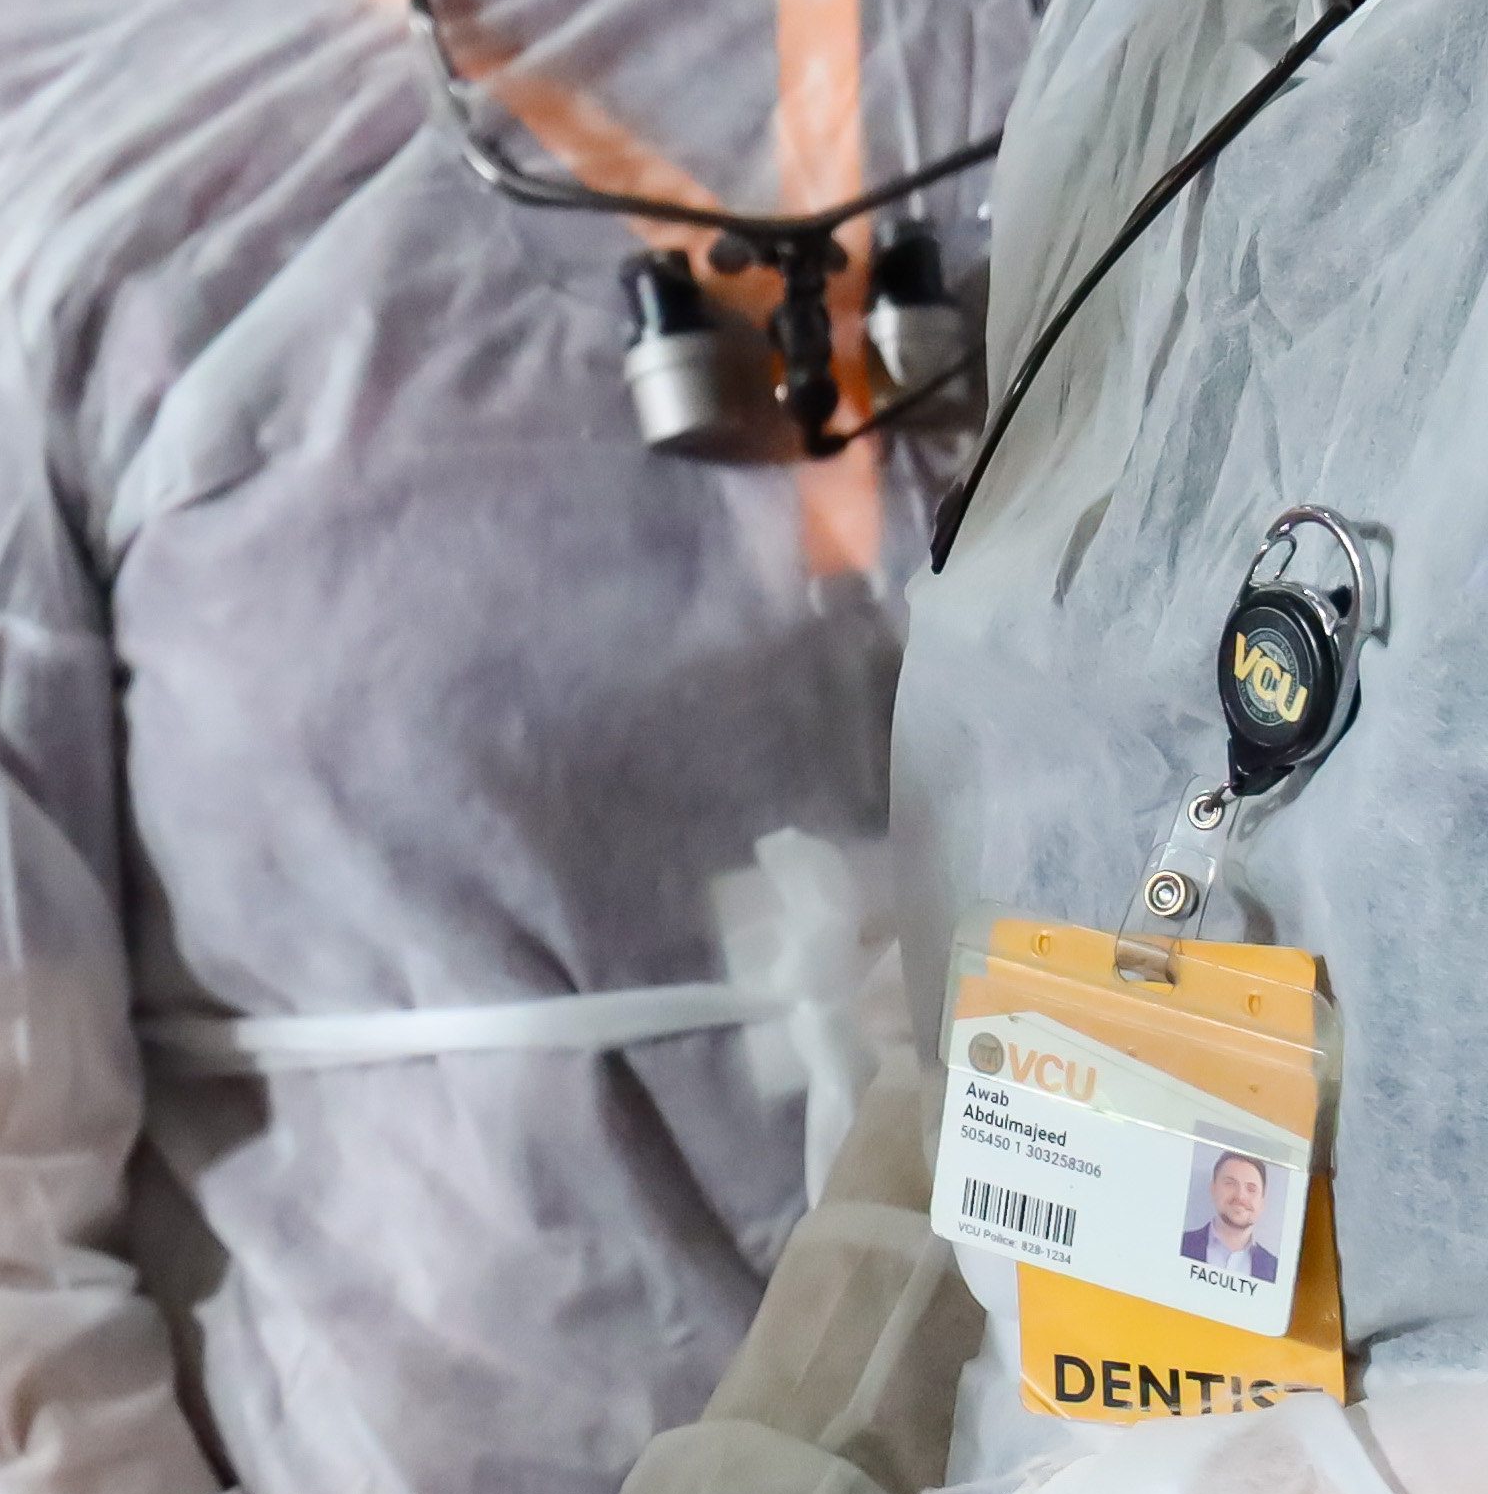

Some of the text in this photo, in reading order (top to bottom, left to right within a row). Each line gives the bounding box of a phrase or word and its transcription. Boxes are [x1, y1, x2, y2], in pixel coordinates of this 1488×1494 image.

[1234, 631, 1308, 723] VCU
[966, 1081, 1010, 1107] Awab
[1007, 1041, 1097, 1103] VCU
[962, 1103, 1067, 1147] Abdulmajeed
[960, 1124, 1011, 1151] 505450
[1025, 1144, 1102, 1178] 303258306
[958, 1221, 981, 1238] VCU
[1021, 1241, 1072, 1265] 828-1234
[1189, 1264, 1259, 1297] FACULTY
